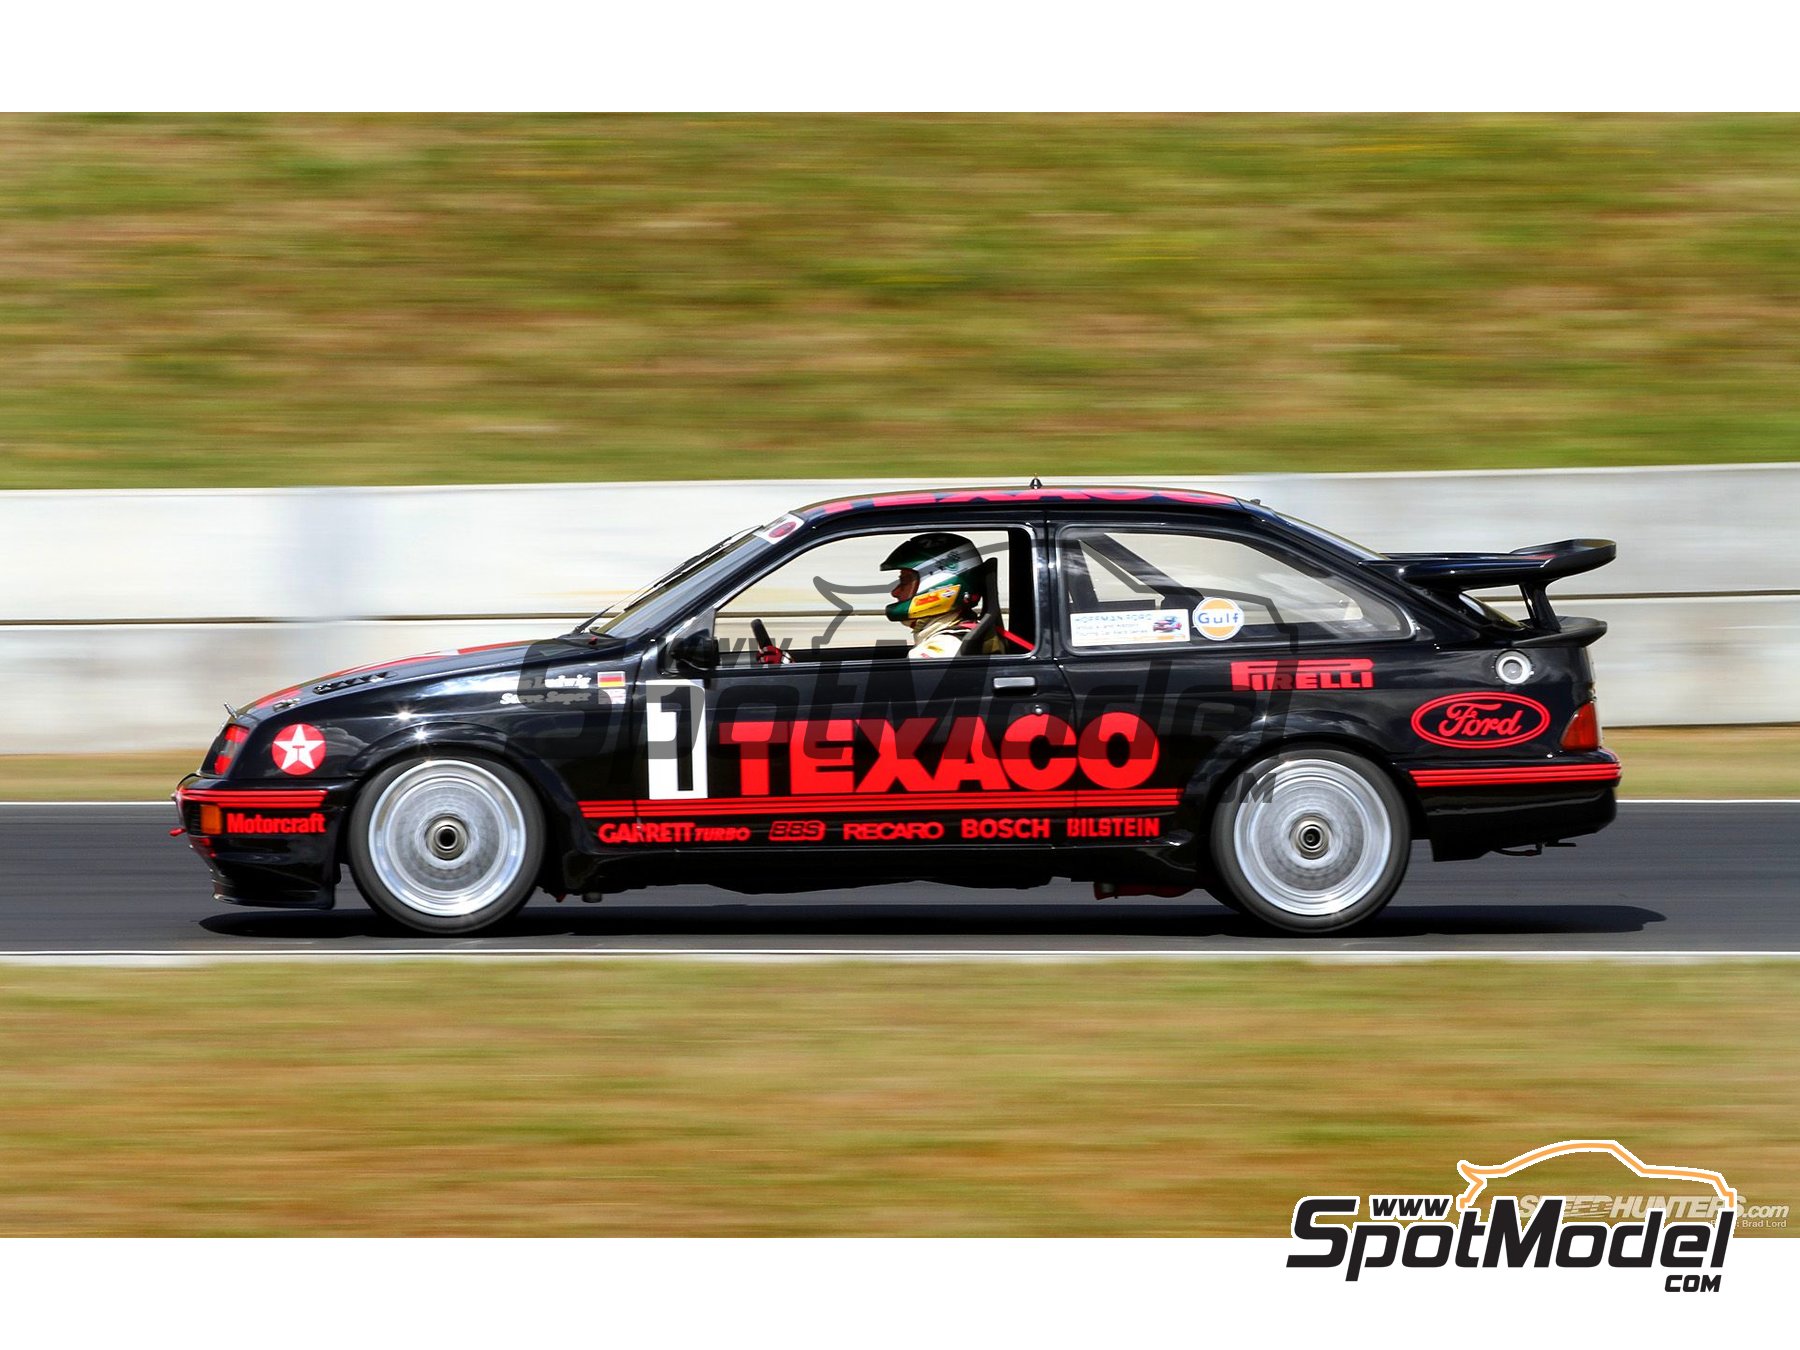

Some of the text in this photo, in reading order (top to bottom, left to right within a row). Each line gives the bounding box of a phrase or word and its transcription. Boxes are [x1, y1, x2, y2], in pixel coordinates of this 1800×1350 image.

[1197, 612, 1239, 624] Gulf
[1231, 658, 1375, 691] PIRELLI
[1438, 702, 1522, 737] Ford
[661, 686, 694, 791] 1
[719, 711, 1160, 796] TEXACO
[226, 812, 326, 834] Motorcraft
[598, 822, 751, 843] GARRETT TURBO
[770, 821, 825, 840] BBS
[843, 822, 944, 841] RECARO
[961, 818, 1050, 839] BOSCH
[1067, 818, 1160, 837] BILSTEIN
